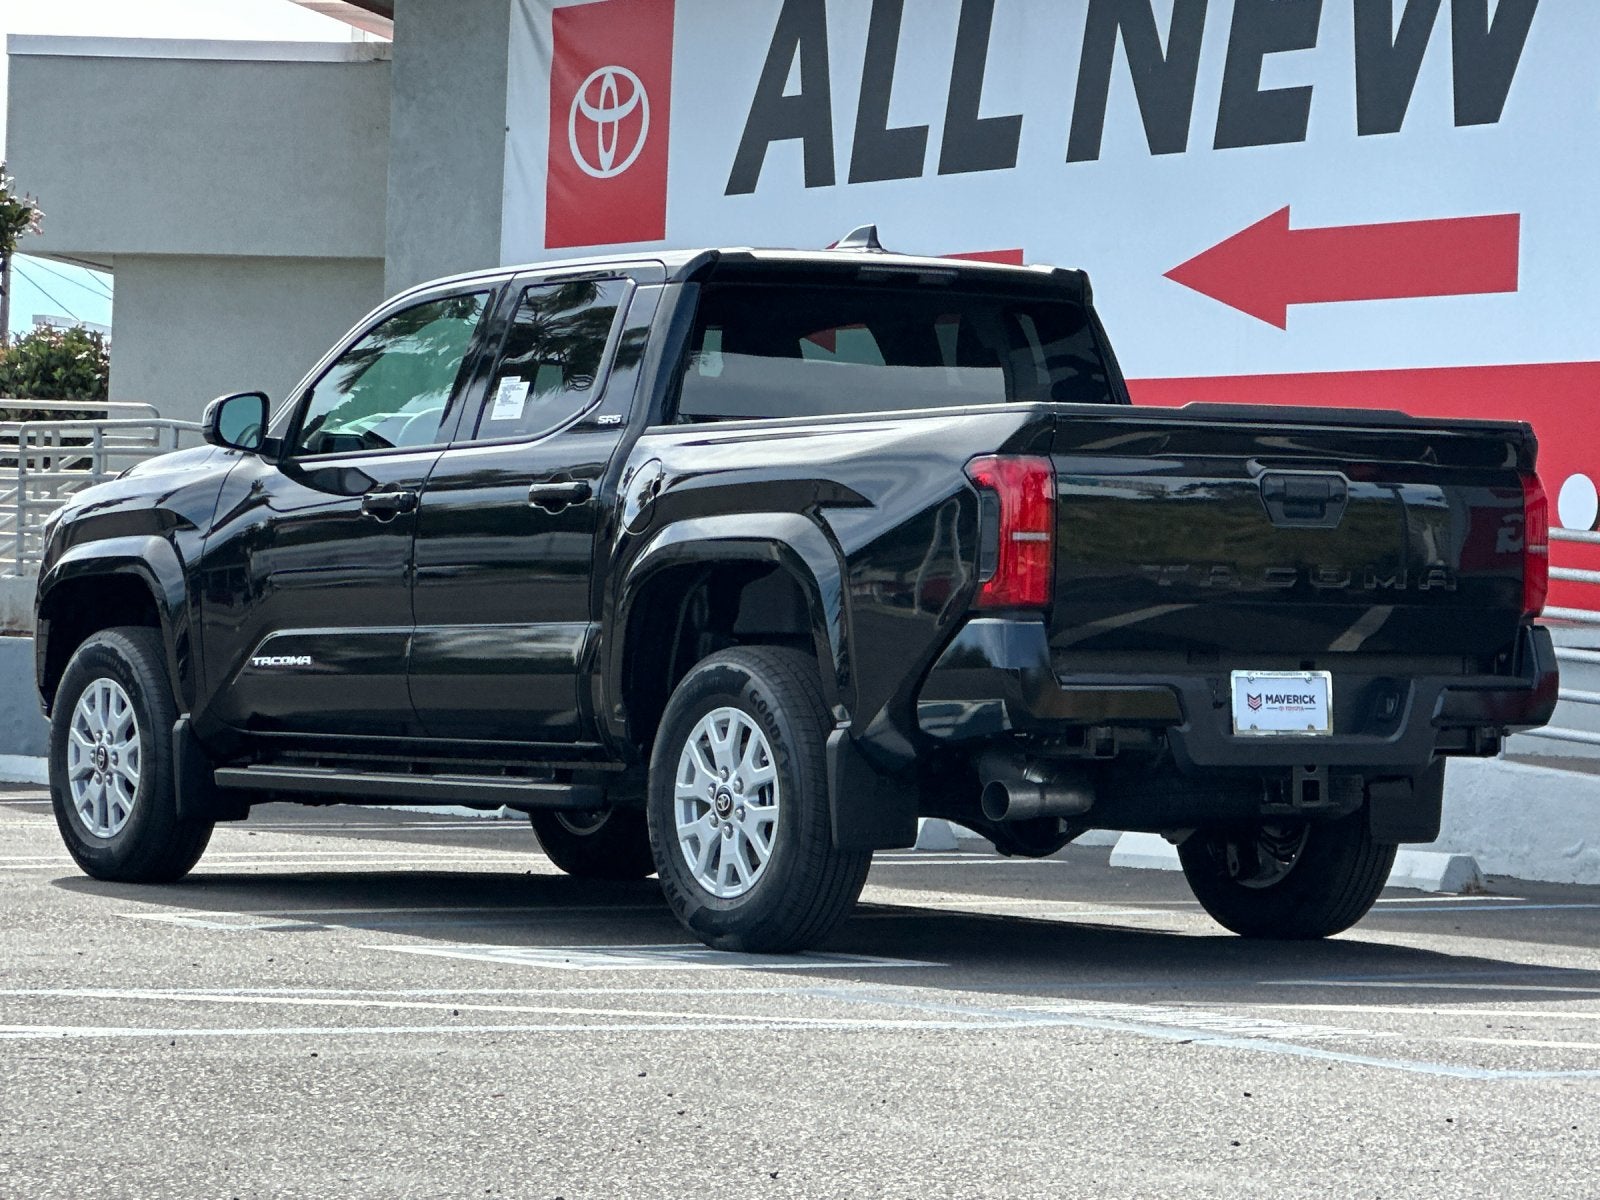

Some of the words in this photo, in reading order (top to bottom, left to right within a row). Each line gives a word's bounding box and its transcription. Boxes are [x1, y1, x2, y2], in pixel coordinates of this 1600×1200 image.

[724, 0, 1023, 196] ALL
[1065, 0, 1540, 163] NEW
[597, 414, 622, 425] SR5
[1138, 562, 1457, 591] TACOMA
[251, 655, 312, 667] TACOMA
[1265, 694, 1316, 705] MAVERICK
